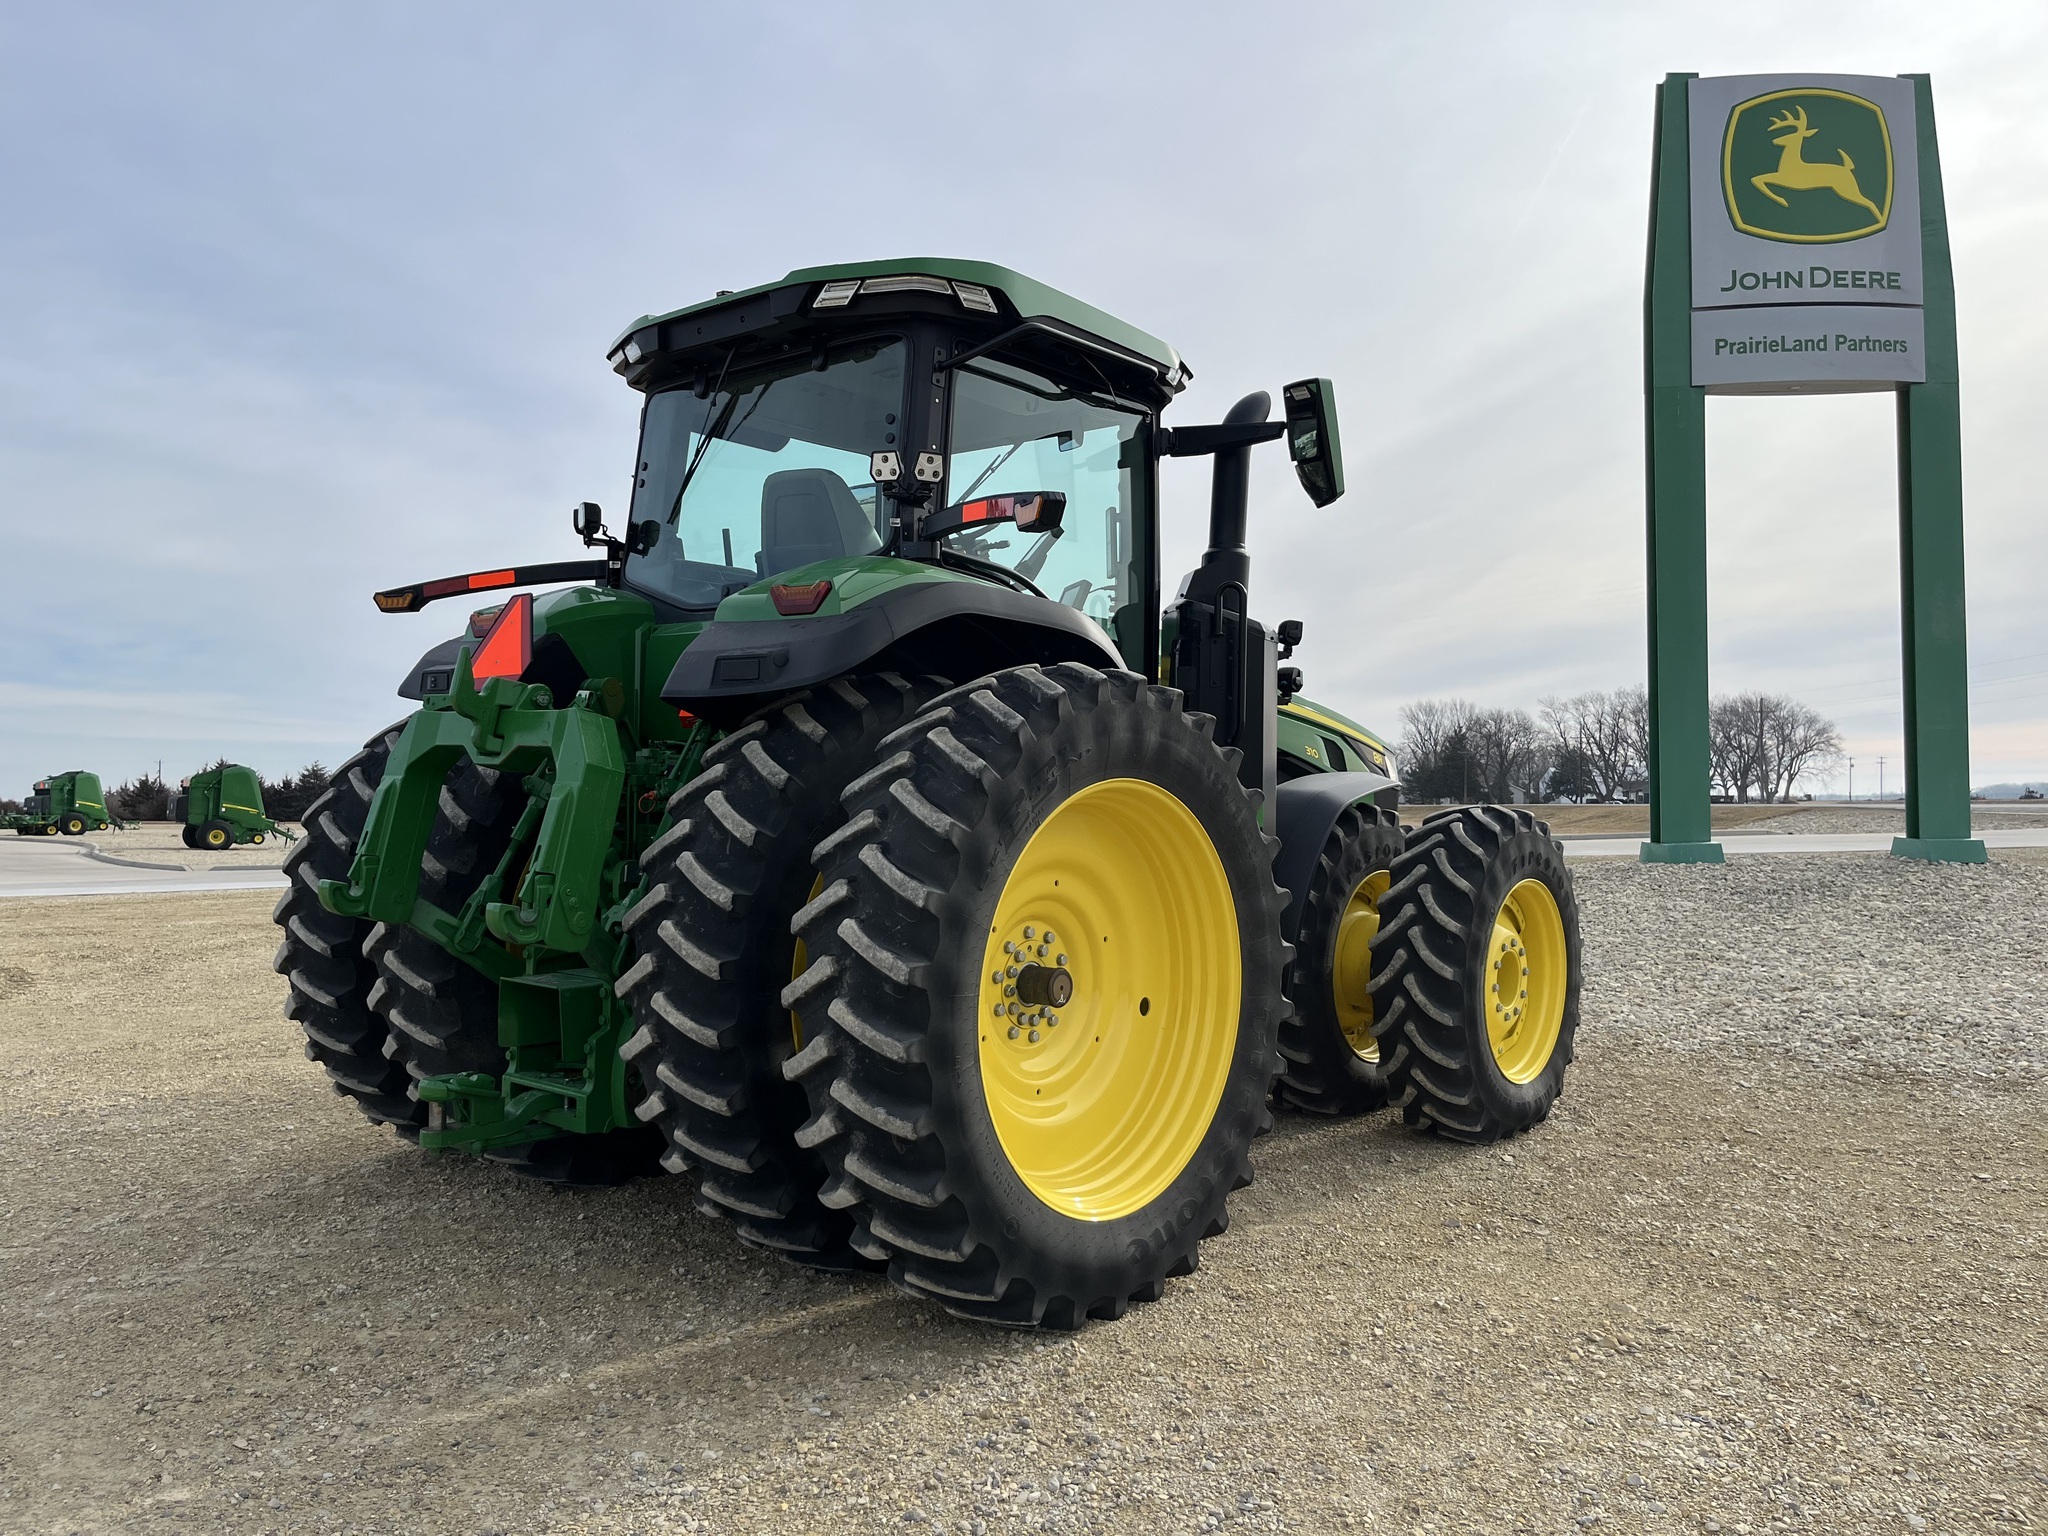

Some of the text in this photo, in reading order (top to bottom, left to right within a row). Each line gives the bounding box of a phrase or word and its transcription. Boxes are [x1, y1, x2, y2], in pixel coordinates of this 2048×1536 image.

[1720, 266, 1902, 292] JOHN DEERE
[1714, 334, 1908, 356] PrairieLand Partners
[1305, 745, 1319, 758] 310
